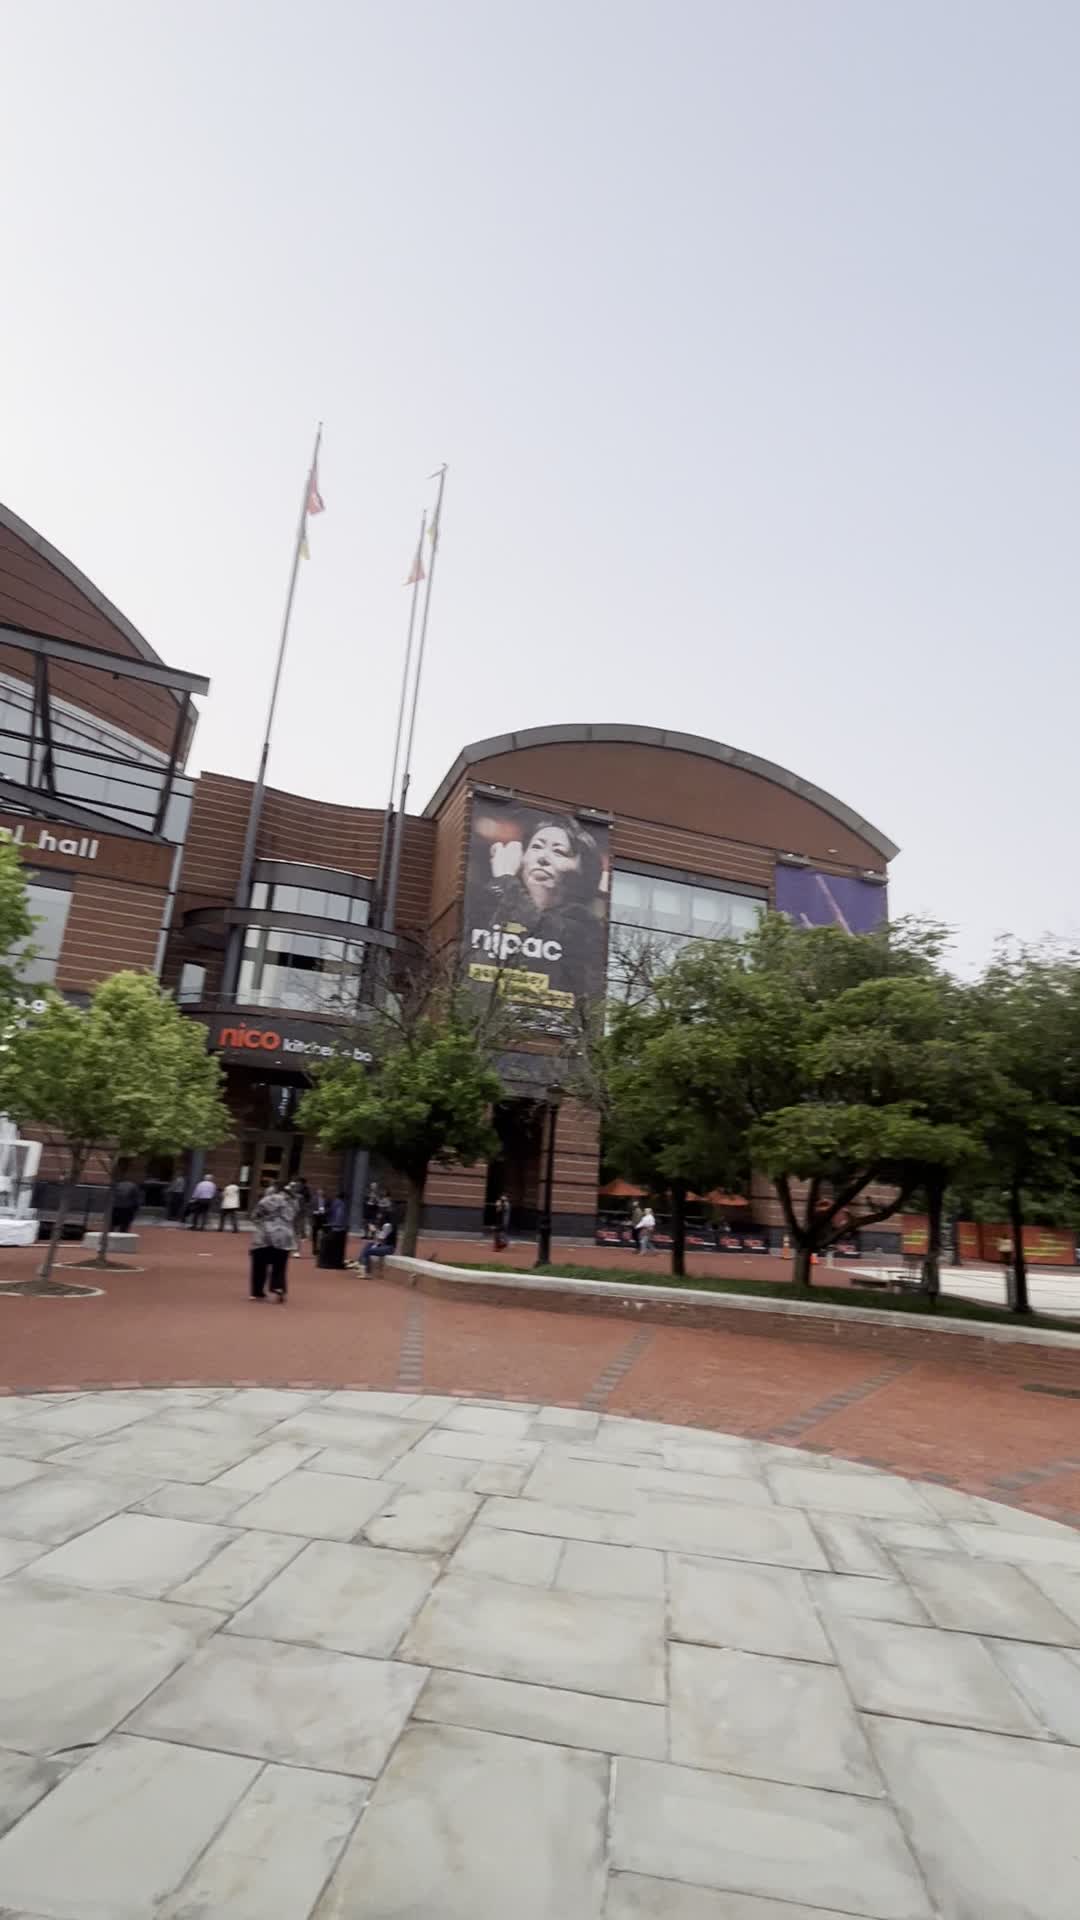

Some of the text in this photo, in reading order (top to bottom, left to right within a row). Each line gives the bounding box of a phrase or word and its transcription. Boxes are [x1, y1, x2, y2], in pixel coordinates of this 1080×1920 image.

[38, 830, 99, 859] hall
[471, 924, 562, 961] njpac
[217, 1022, 281, 1050] nico
